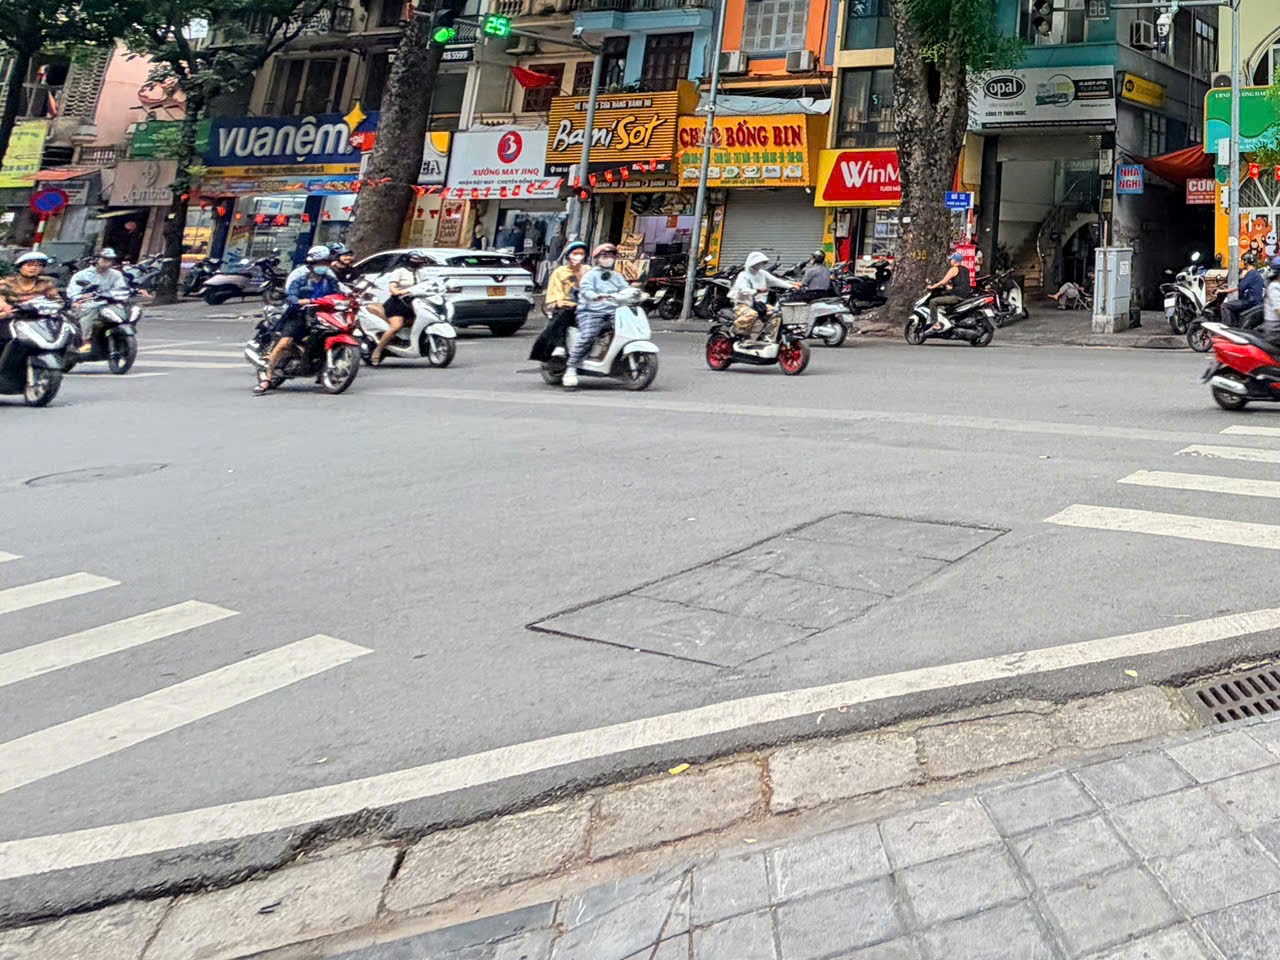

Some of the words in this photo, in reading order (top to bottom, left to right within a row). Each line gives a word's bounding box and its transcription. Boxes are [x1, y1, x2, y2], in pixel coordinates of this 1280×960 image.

[485, 17, 505, 35] 25
[989, 80, 1017, 98] opal
[680, 121, 722, 148] CHO
[773, 124, 802, 146] BIN
[501, 168, 520, 176] MAY
[841, 160, 902, 188] WinM
